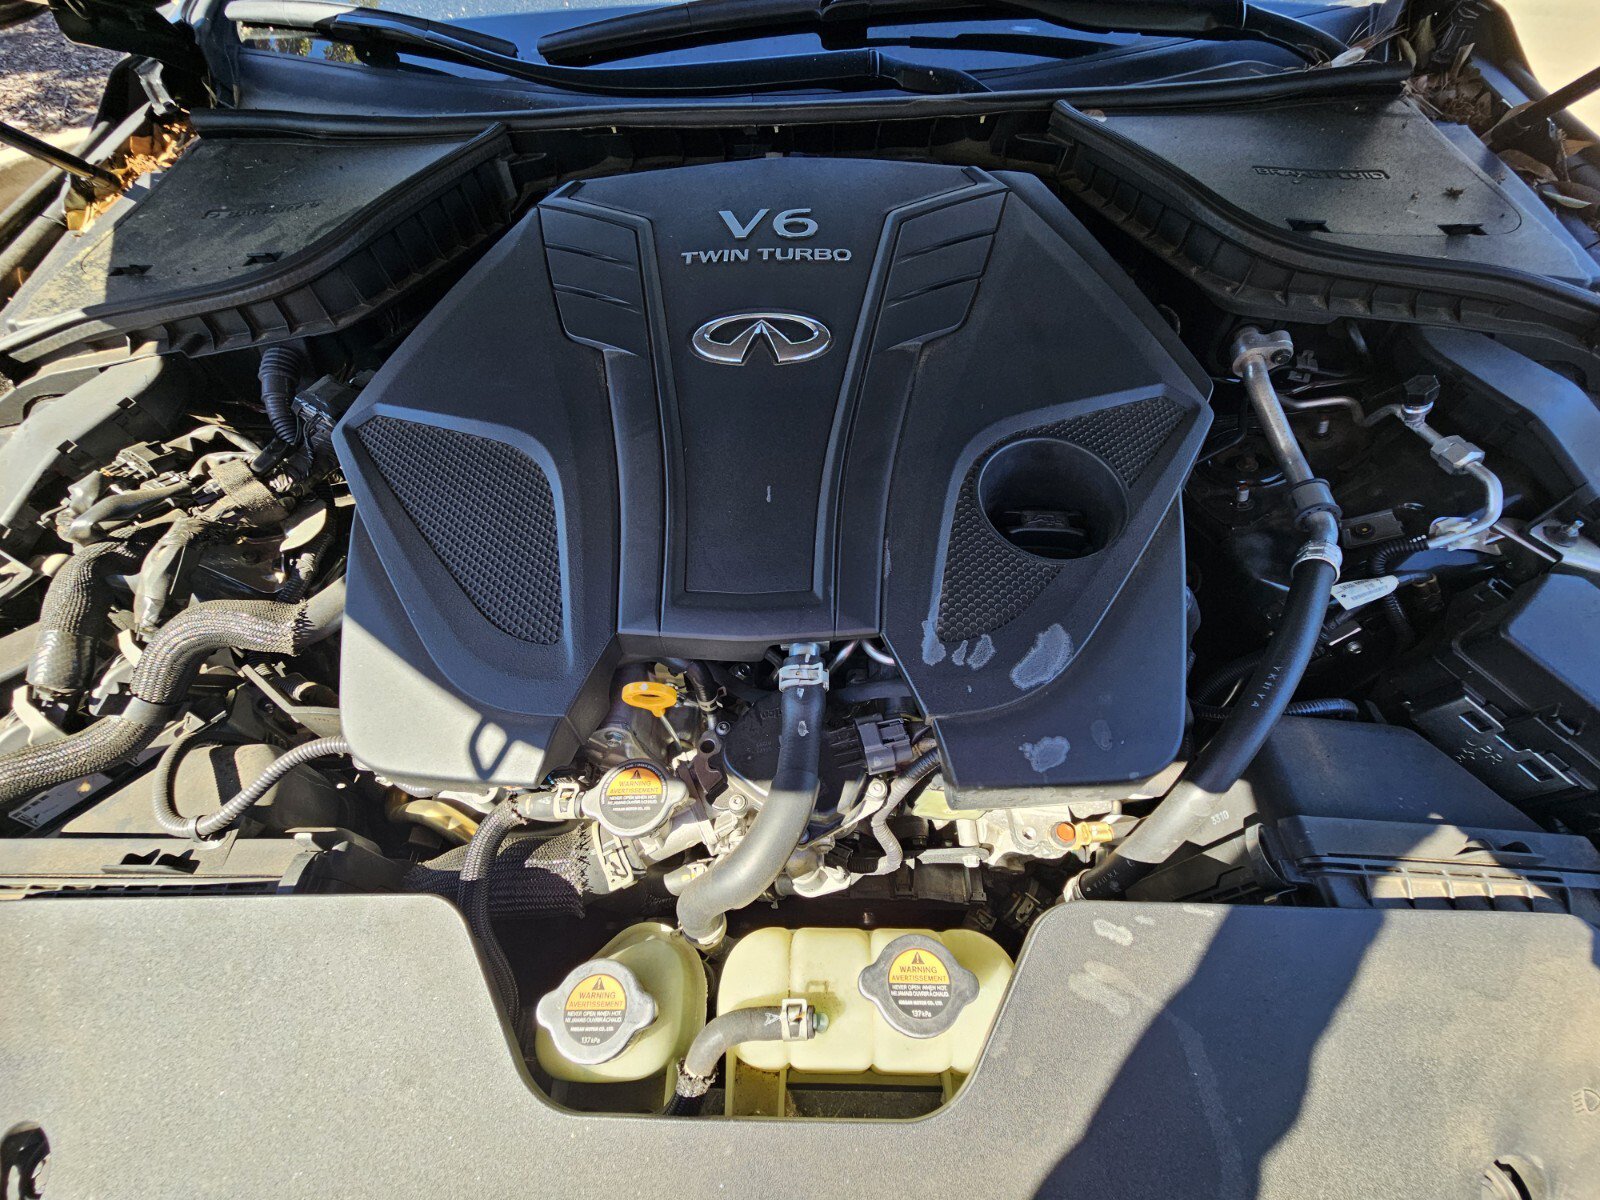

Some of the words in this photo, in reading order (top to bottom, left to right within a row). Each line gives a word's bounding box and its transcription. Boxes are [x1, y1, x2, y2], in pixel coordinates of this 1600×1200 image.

[718, 208, 819, 239] V6
[681, 249, 749, 264] TWIN
[757, 248, 852, 262] TURBO
[1211, 810, 1230, 825] 3310
[899, 965, 938, 974] WARNING
[579, 991, 616, 999] WARNING
[569, 1000, 623, 1008] AVERTISSEMENT
